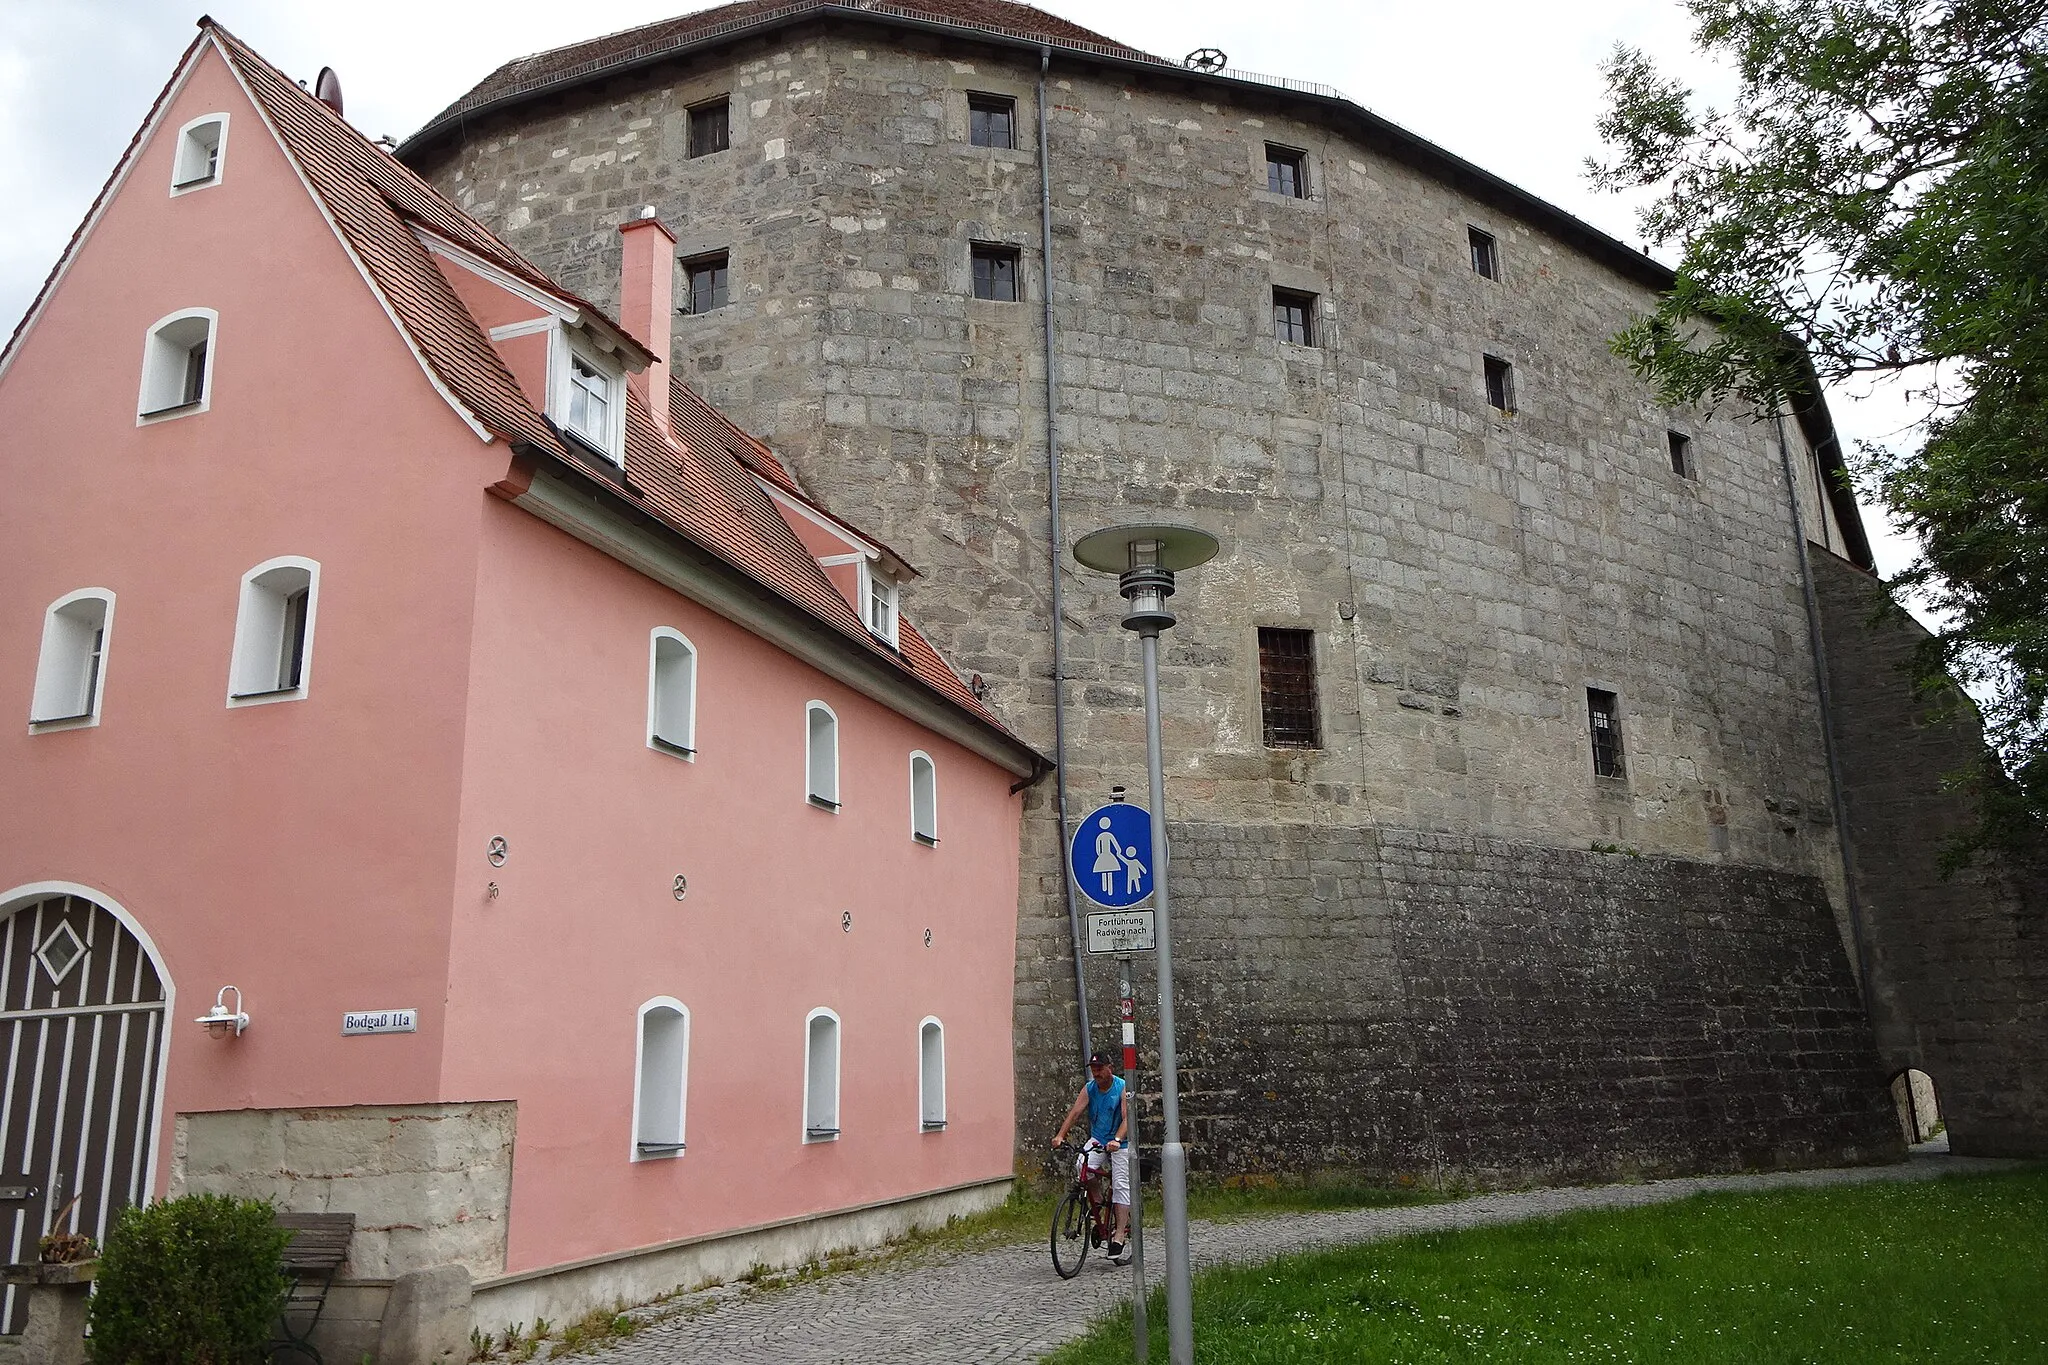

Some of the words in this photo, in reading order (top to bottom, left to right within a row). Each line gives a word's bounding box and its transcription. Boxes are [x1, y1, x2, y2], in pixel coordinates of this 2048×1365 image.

[1098, 918, 1143, 926] Fortführung
[1096, 928, 1126, 937] Radweg
[1128, 926, 1147, 935] nach
[346, 1014, 388, 1031] Bodgaß
[392, 1013, 410, 1026] 11a
